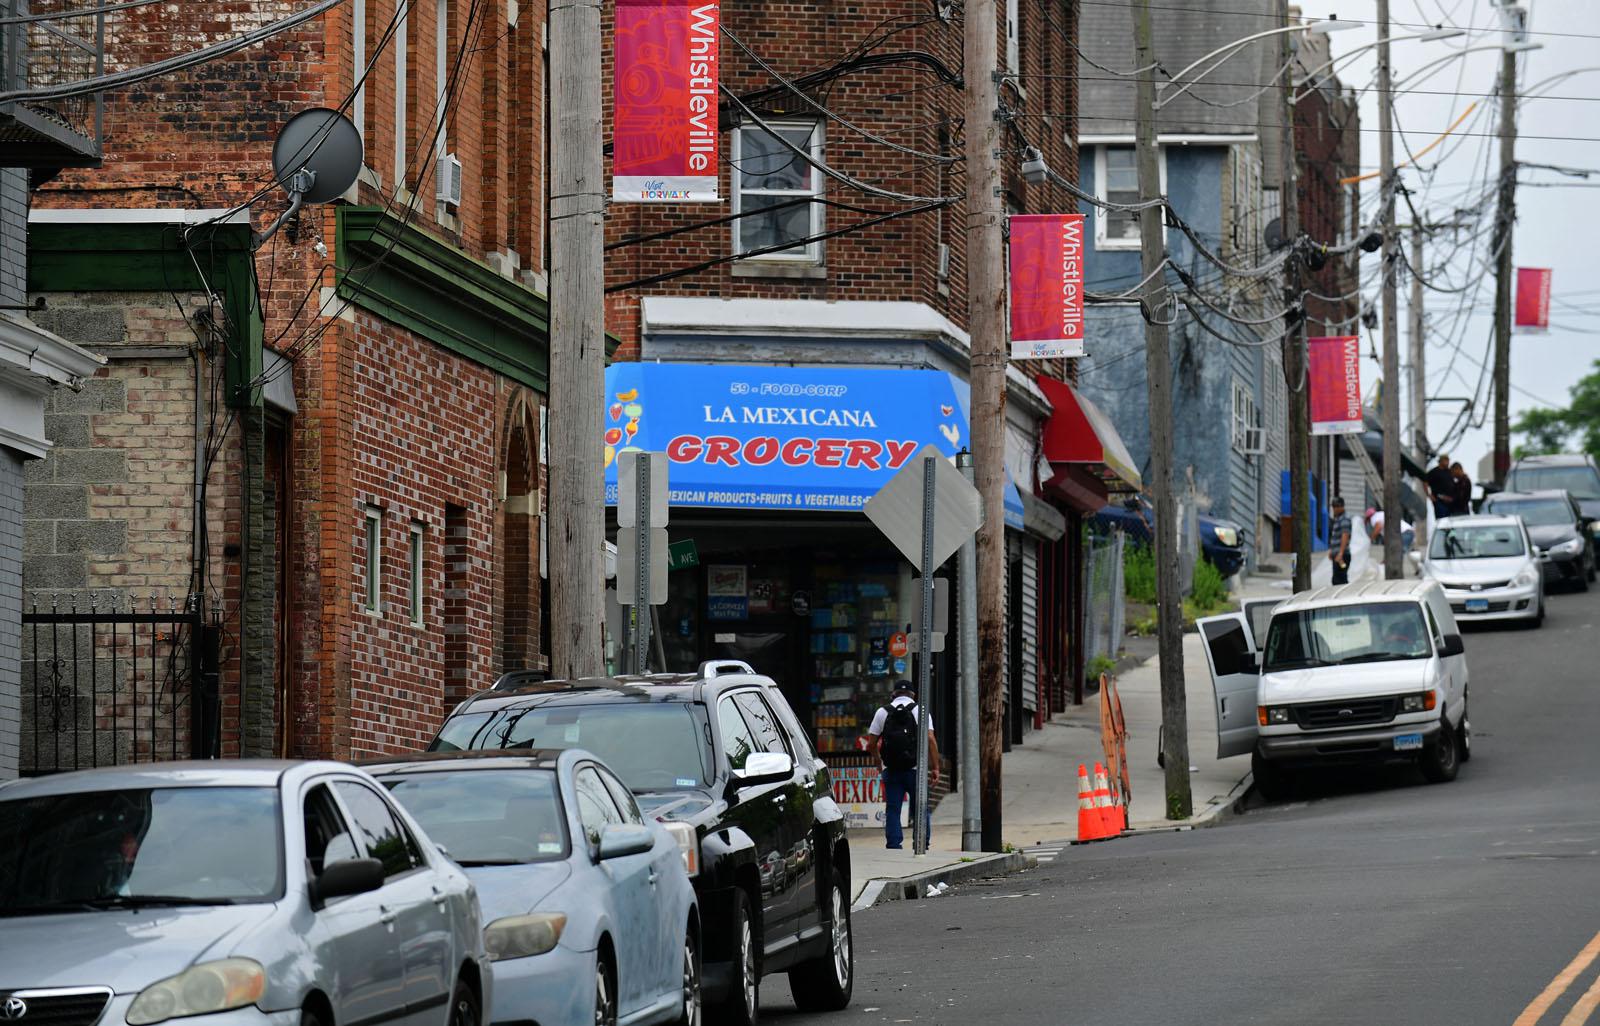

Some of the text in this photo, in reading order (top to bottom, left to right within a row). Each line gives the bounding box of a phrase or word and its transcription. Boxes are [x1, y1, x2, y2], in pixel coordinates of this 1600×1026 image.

[689, 4, 714, 171] Whistleville
[641, 190, 690, 199] NORWALK
[1063, 220, 1081, 336] Whistleville
[731, 382, 749, 395] 59
[703, 405, 877, 428] LA MEXICANA
[667, 434, 919, 472] GROCERY
[795, 493, 802, 505] &
[680, 552, 695, 565] AVE
